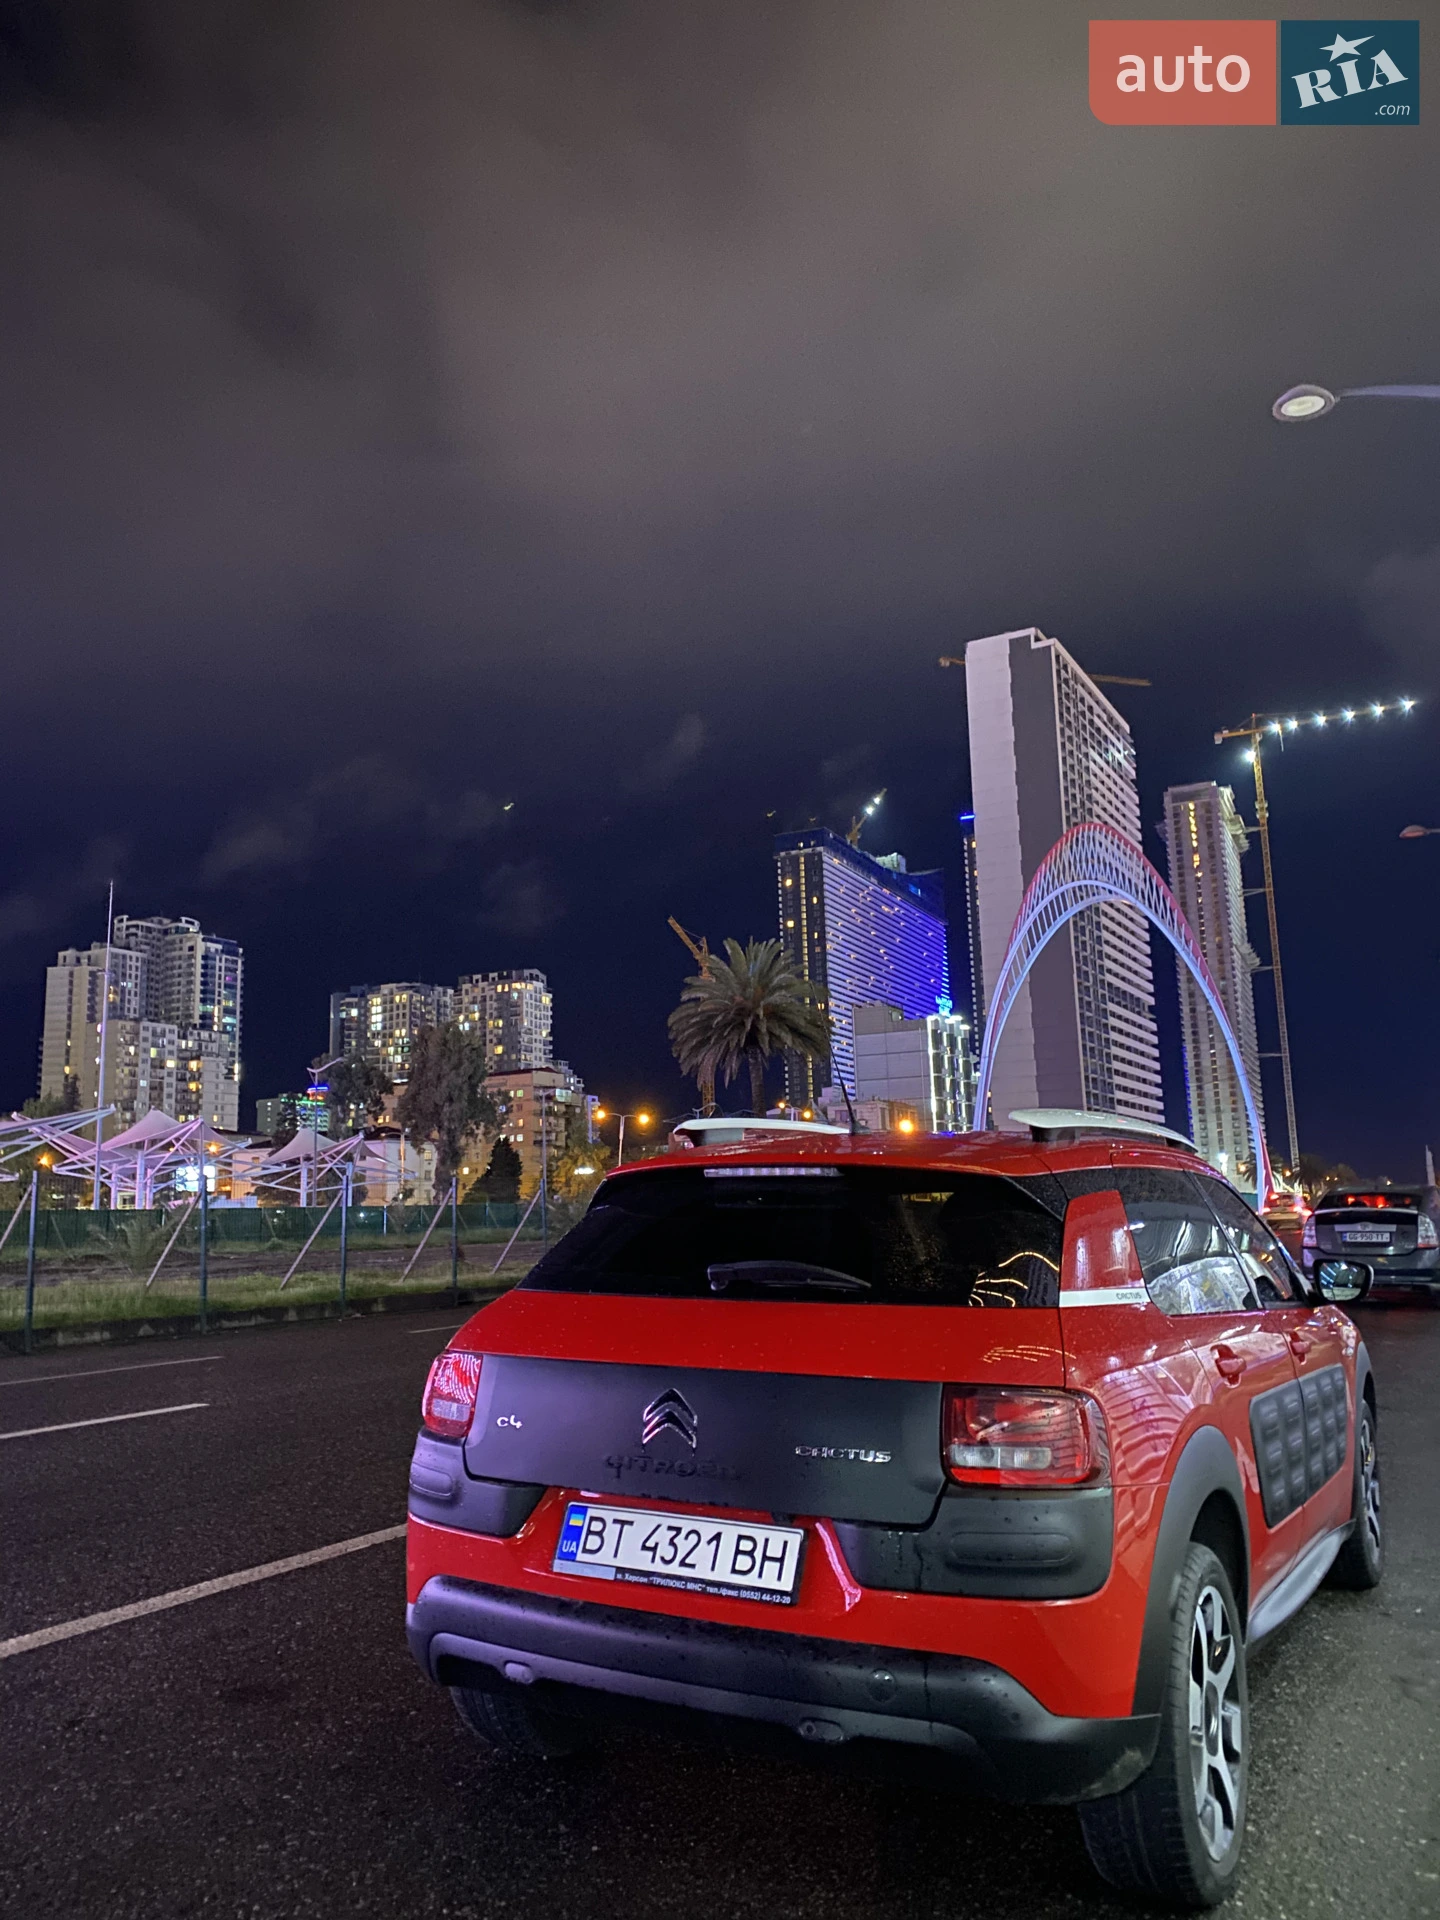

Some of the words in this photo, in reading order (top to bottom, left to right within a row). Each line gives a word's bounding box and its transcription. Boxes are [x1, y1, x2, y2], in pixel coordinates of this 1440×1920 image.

[1116, 1292, 1142, 1300] CACTUS
[795, 1445, 892, 1463] CACTUS
[562, 1540, 577, 1554] UA
[580, 1515, 634, 1559] BT
[641, 1523, 722, 1571] 4321
[730, 1533, 788, 1582] BH
